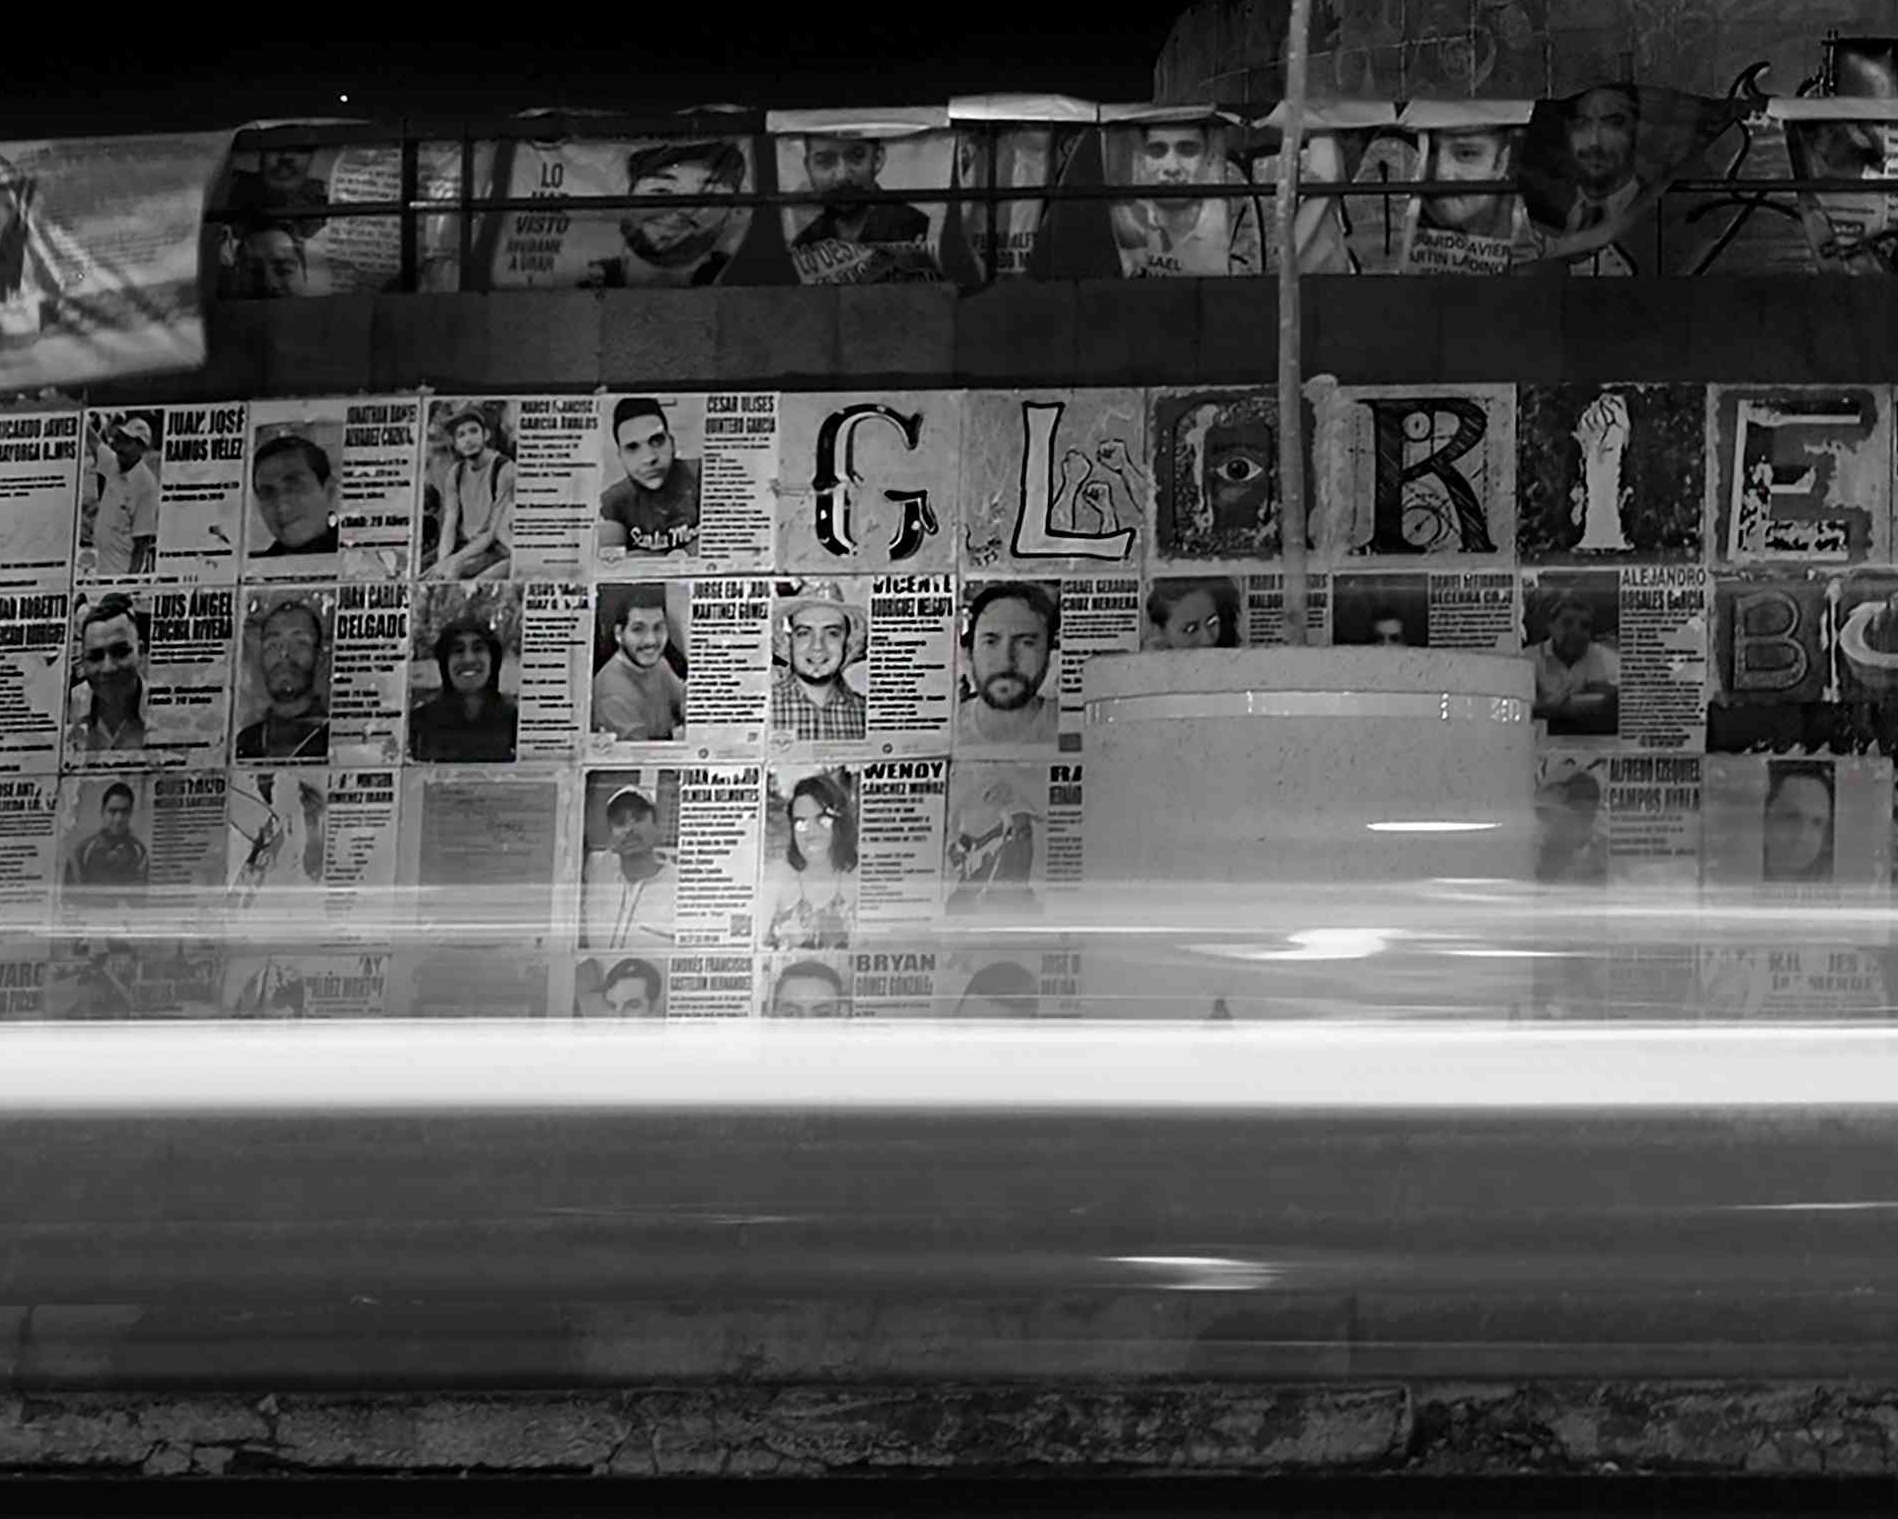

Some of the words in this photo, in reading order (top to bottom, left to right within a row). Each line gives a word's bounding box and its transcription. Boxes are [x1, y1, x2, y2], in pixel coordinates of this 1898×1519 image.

[540, 161, 564, 188] LO
[1621, 567, 1706, 587] ALEJANDRO
[154, 594, 187, 619] LUIS
[1061, 597, 1089, 611] CRUZ
[1091, 595, 1139, 610] HERRERA
[336, 614, 408, 640] DELGADO
[863, 762, 944, 780] WENDY
[1610, 757, 1653, 782] ALFREDO
[855, 953, 936, 971] BRYAN
